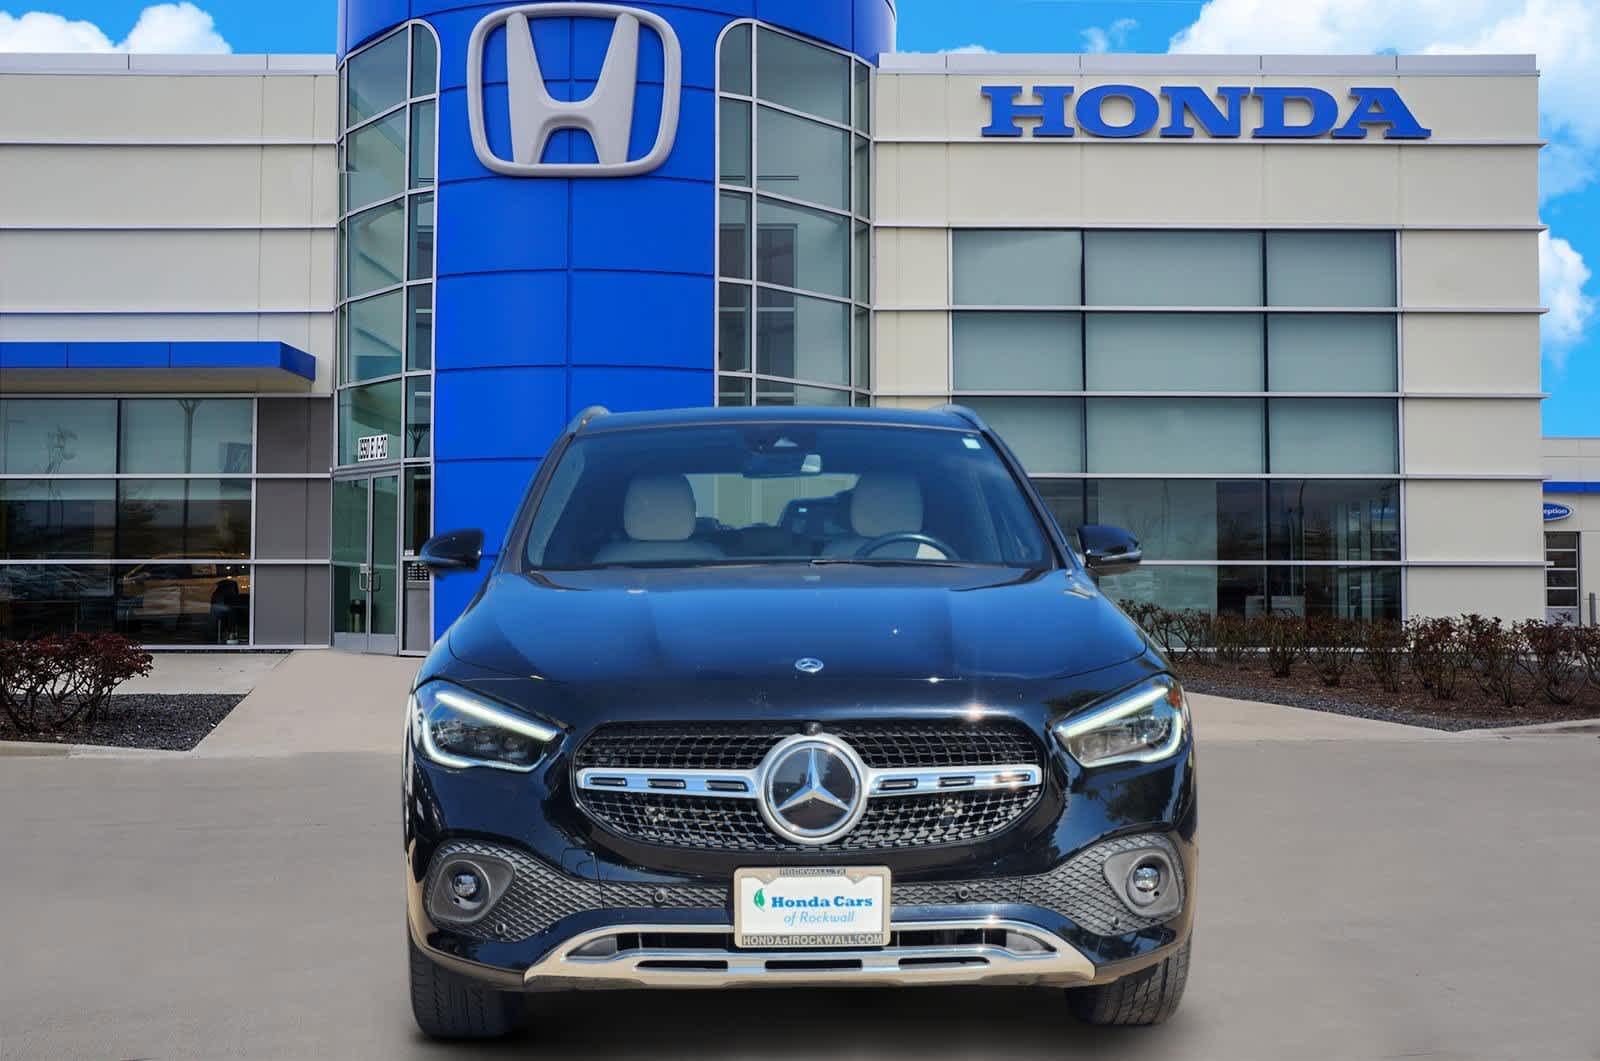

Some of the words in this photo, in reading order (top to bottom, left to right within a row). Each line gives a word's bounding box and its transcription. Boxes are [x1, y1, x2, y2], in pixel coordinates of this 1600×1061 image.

[980, 84, 1433, 140] HONDA
[771, 896, 831, 908] Honda
[834, 895, 873, 907] Cars
[783, 911, 797, 926] of
[800, 911, 855, 923] Rockwall
